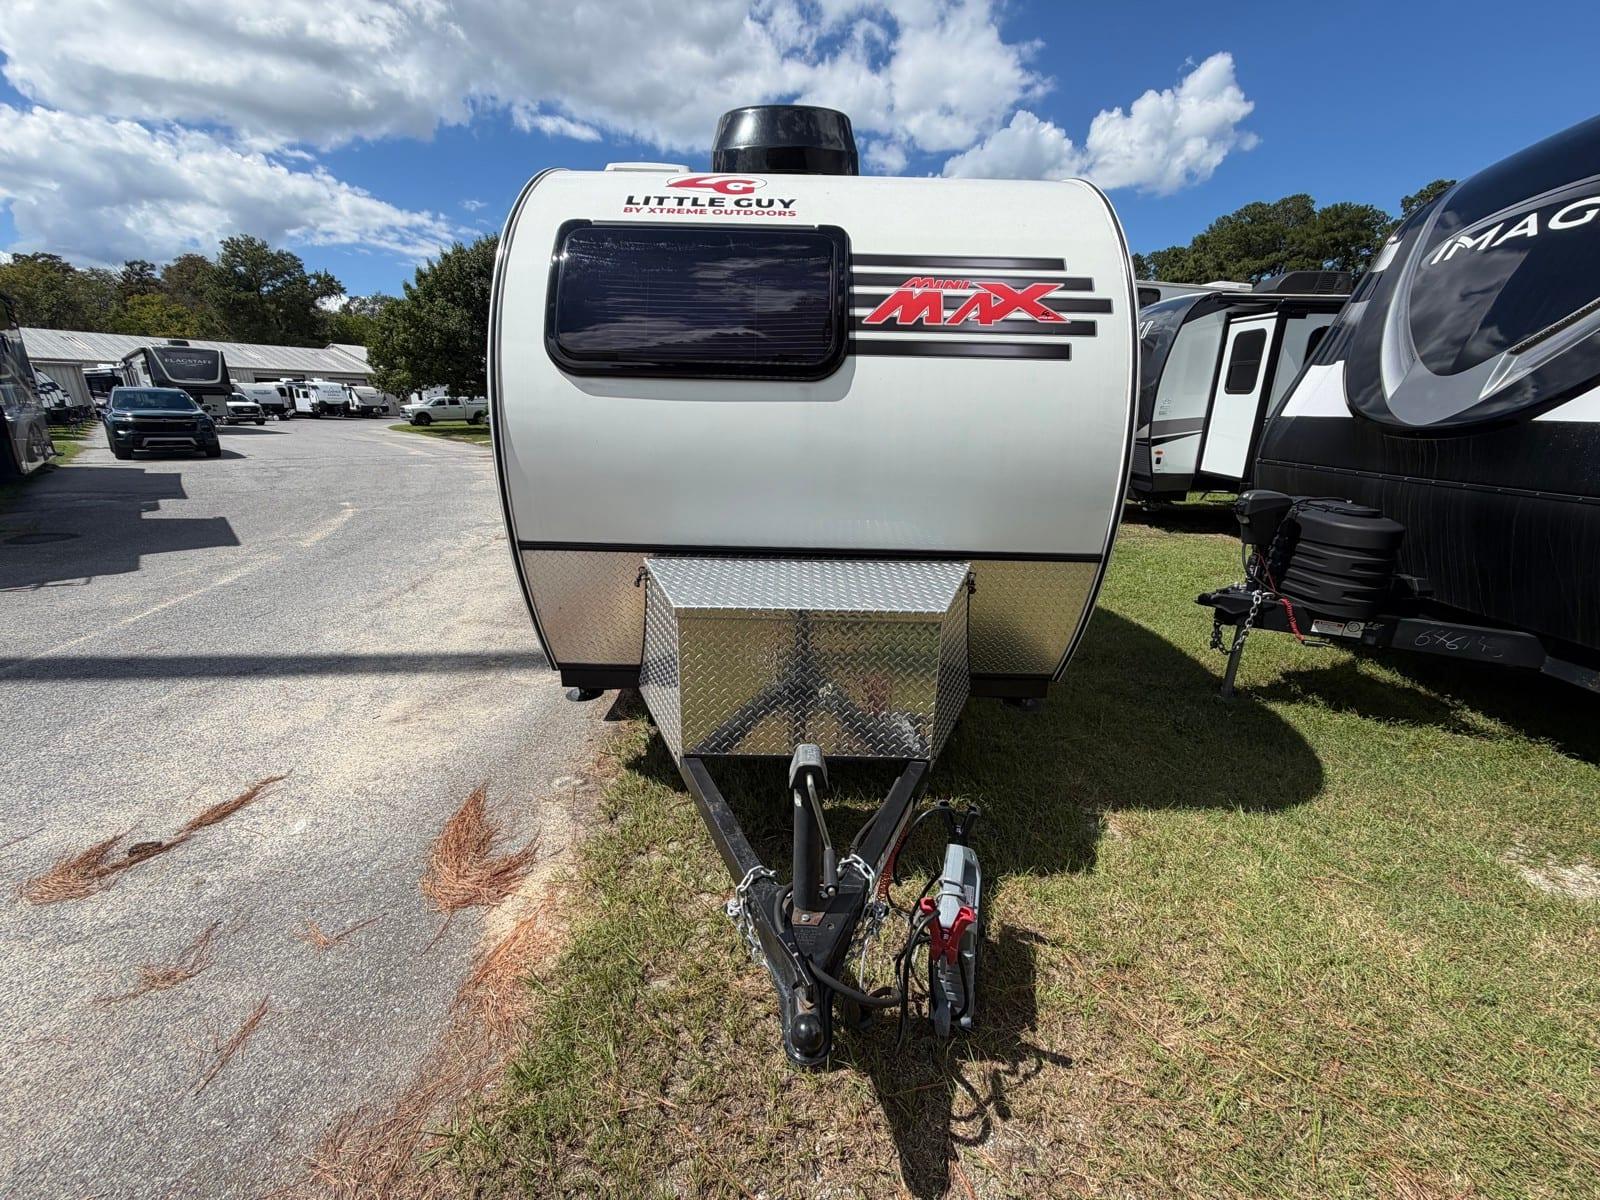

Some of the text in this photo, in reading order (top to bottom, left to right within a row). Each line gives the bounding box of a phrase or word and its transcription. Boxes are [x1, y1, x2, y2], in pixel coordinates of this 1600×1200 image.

[625, 195, 797, 209] LITTLE GUY
[647, 207, 708, 215] XTREME
[712, 208, 797, 217] OUTDOORS
[1430, 196, 1600, 265] IMAG
[898, 276, 971, 290] MINI
[862, 281, 1071, 326] MAX
